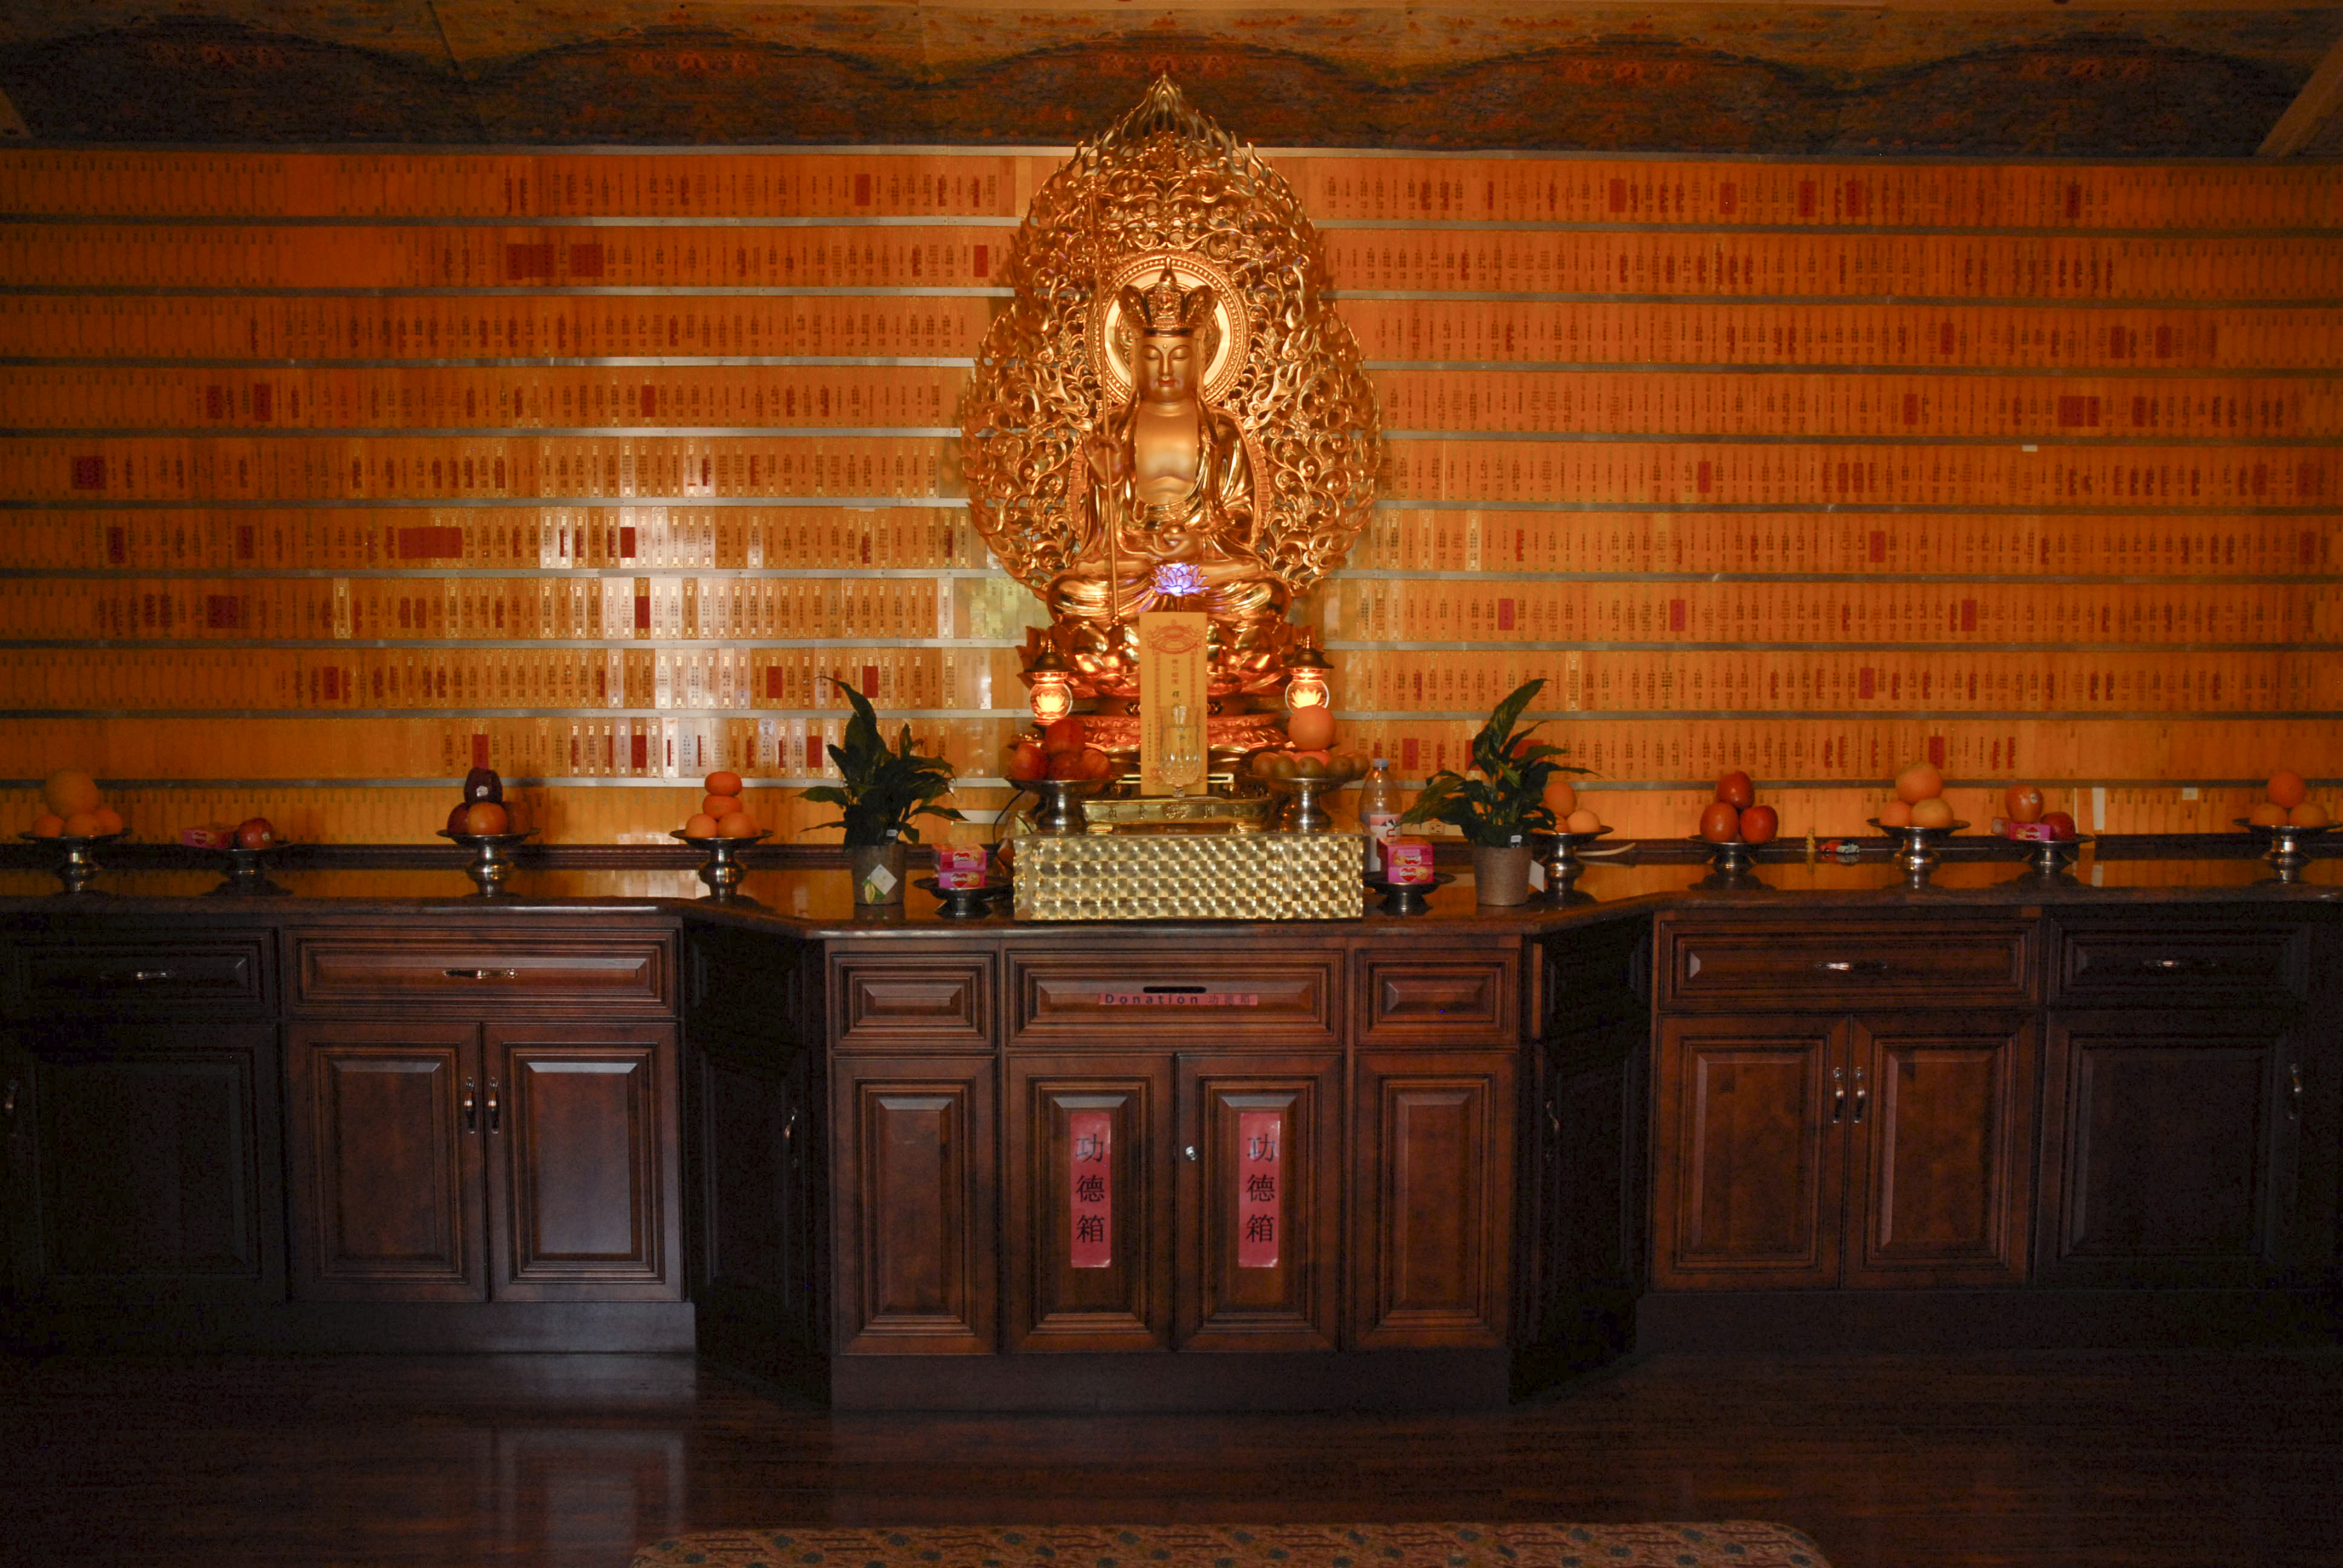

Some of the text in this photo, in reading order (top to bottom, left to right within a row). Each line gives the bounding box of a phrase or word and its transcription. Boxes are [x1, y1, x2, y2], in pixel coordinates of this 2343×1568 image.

[1104, 994, 1199, 1004] Donation
[1075, 1134, 1105, 1244] 功德箱
[1246, 1133, 1276, 1243] 功德箱
